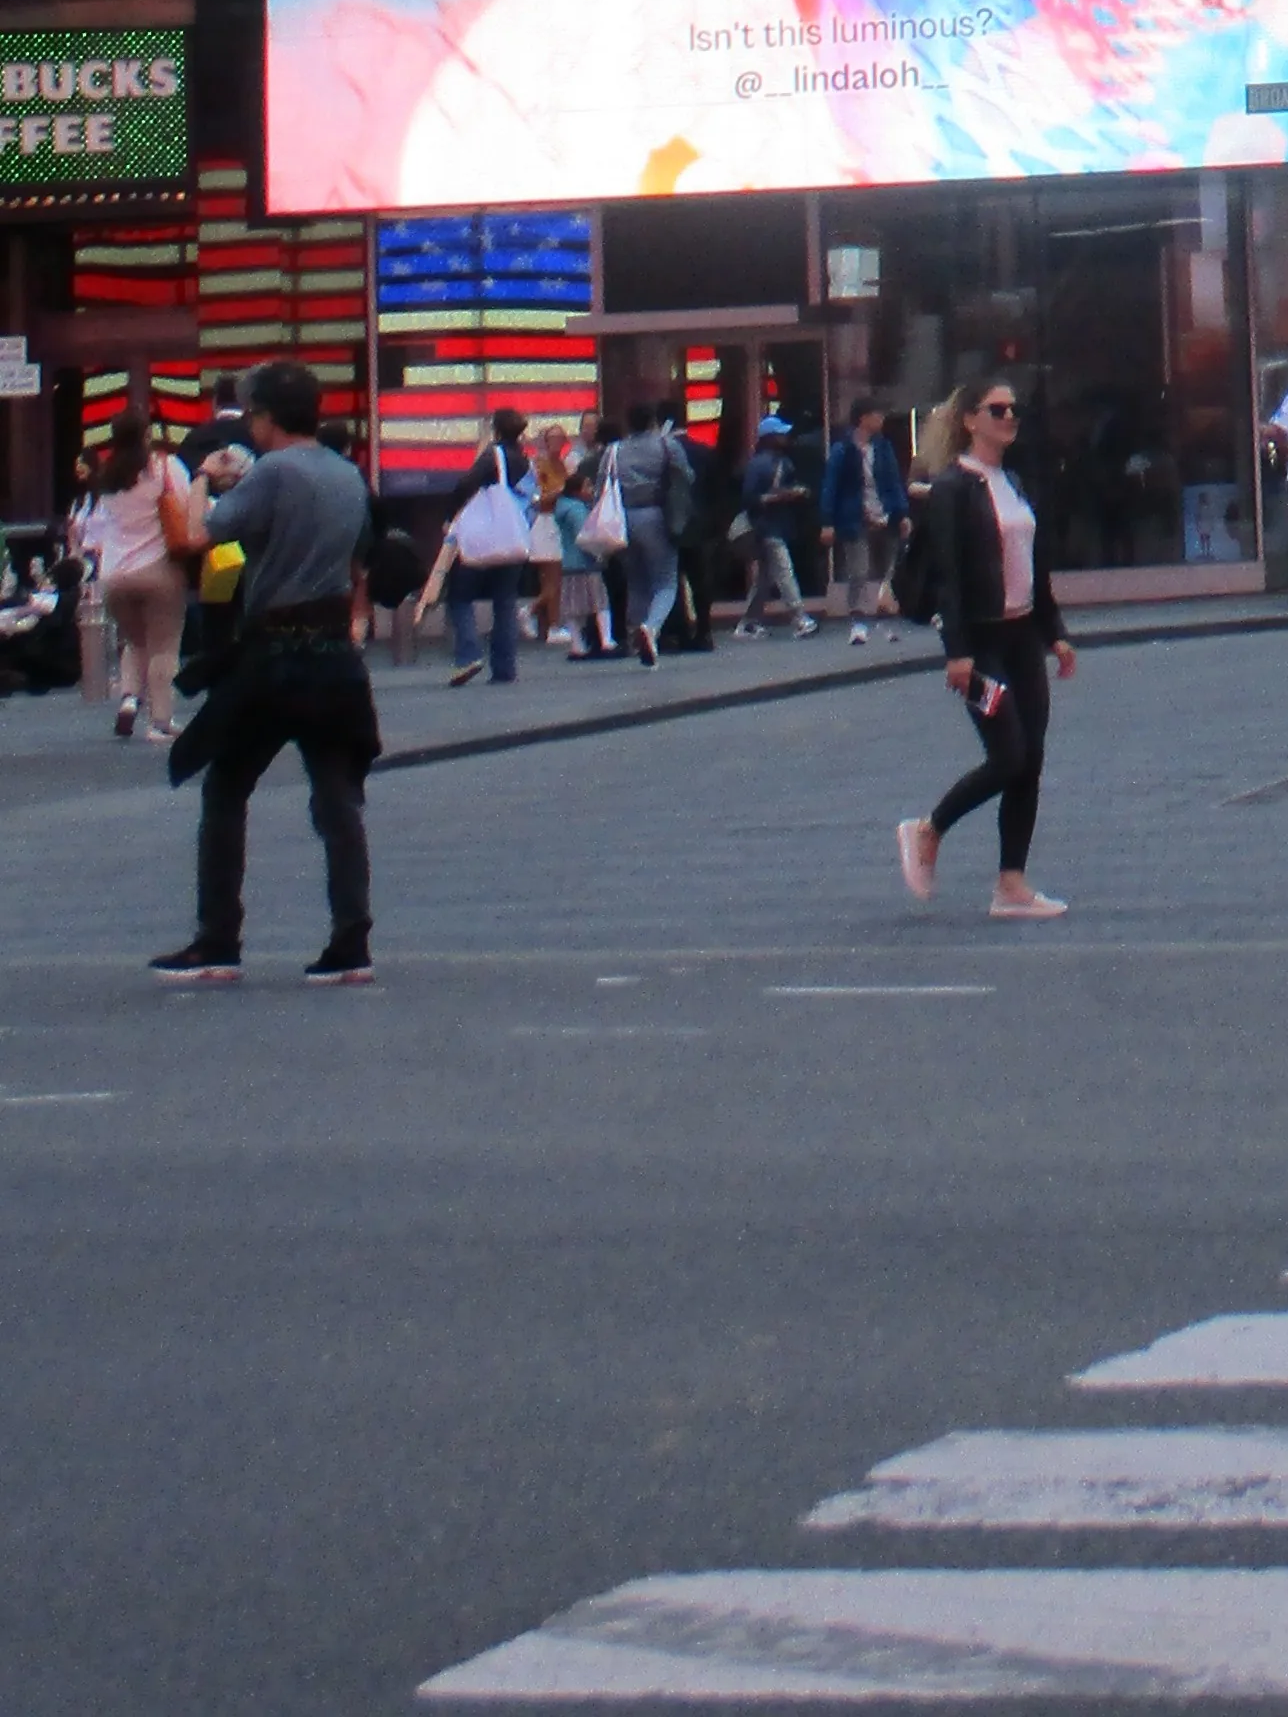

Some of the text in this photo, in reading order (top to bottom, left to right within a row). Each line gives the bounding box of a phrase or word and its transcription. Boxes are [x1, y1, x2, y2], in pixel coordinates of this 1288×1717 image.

[689, 8, 993, 52] Isn't this luminous?
[1, 57, 179, 102] BUCKS
[0, 114, 116, 155] FFEE
